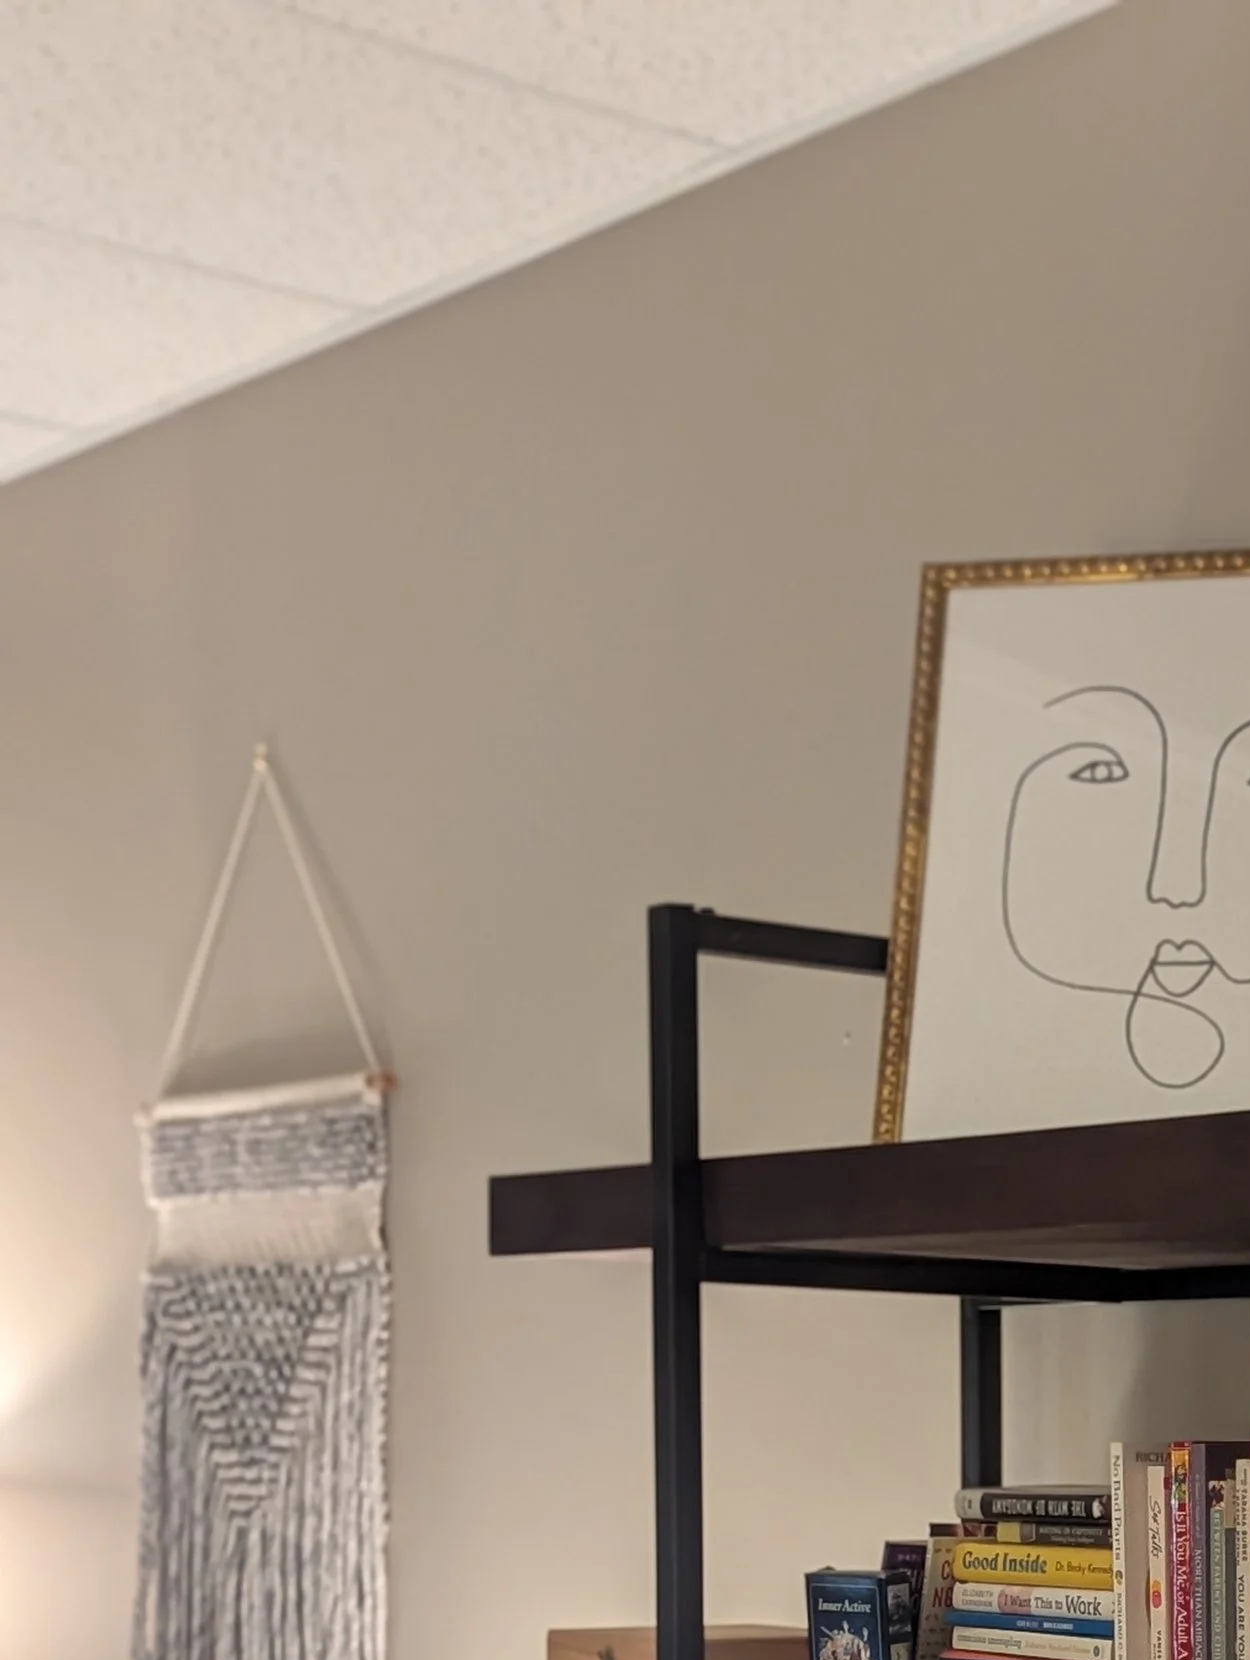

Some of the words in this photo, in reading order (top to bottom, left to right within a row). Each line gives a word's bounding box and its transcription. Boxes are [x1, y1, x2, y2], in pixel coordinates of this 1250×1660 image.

[1112, 1455, 1121, 1476] No
[1113, 1480, 1122, 1513] Bad
[1114, 1515, 1122, 1560] Parts
[1193, 1550, 1202, 1583] MORE
[1194, 1585, 1202, 1618] THAN
[1237, 1574, 1245, 1602] YOU
[1237, 1604, 1245, 1630] ARE
